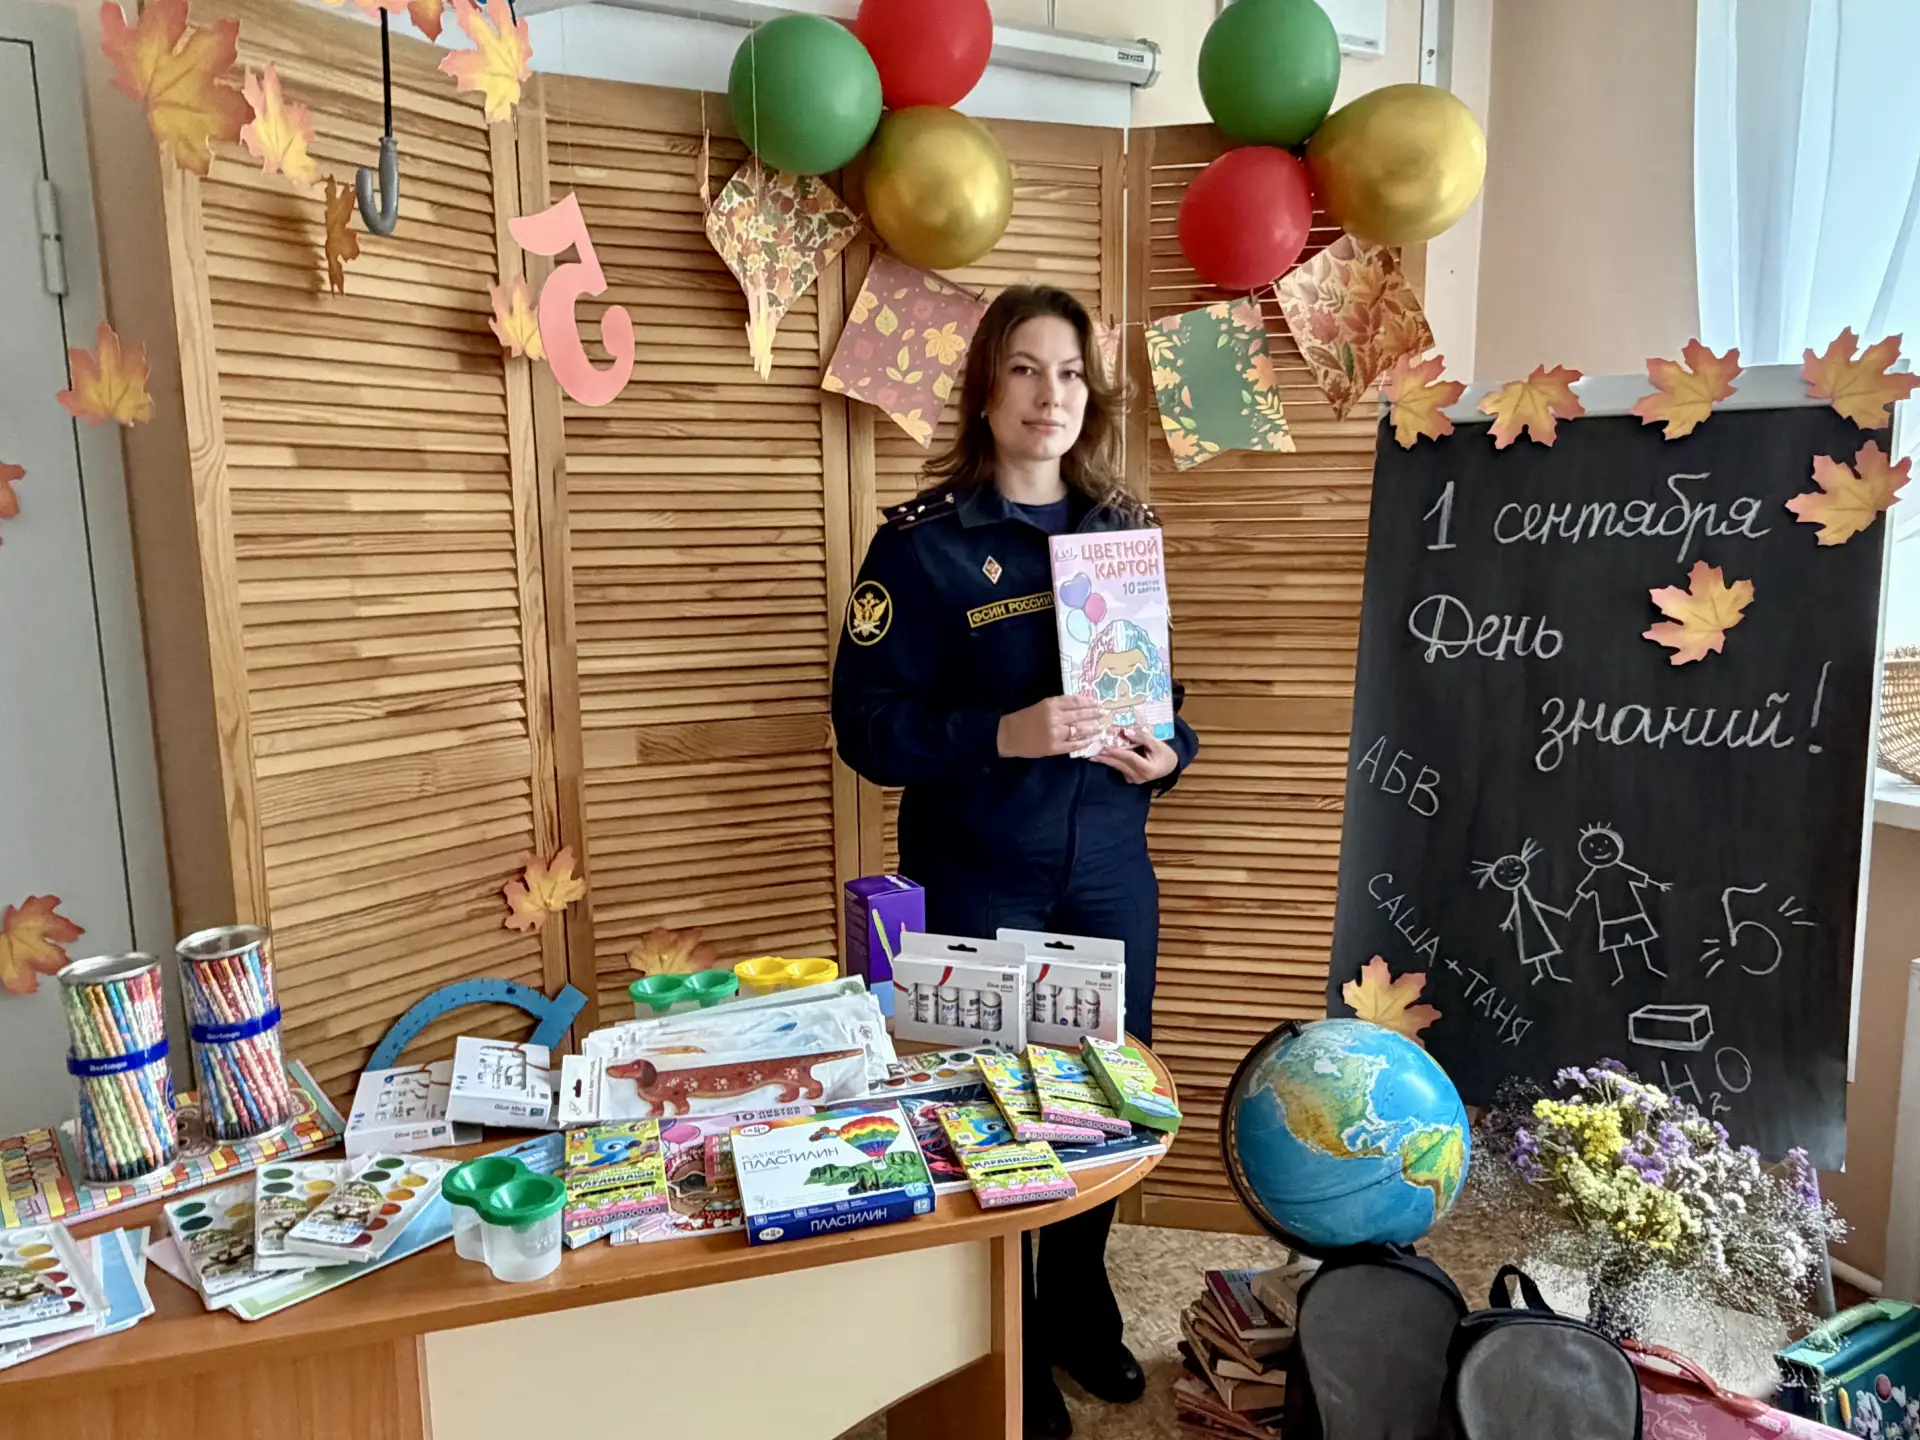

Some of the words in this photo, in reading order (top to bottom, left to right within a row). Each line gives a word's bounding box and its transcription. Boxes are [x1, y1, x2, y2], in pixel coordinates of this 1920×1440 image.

[1423, 481, 1457, 550] 1
[1493, 473, 1771, 563] сентября
[1080, 537, 1160, 563] ЦВЕТНОЙ
[1095, 558, 1160, 580] КАРТОН
[1122, 581, 1136, 595] 10
[972, 604, 1006, 622] ФСИН
[1008, 595, 1053, 613] РОССИИ
[1409, 594, 1564, 663] День
[1356, 735, 1442, 817] АБВ
[1722, 882, 1783, 975] 5
[89, 1061, 128, 1072] Berlingo
[733, 1112, 755, 1122] 10
[743, 1147, 839, 1171] ПЛАСТИЛИН
[915, 1200, 928, 1210] 12
[810, 1208, 887, 1232] ПЛАСТИЛИН
